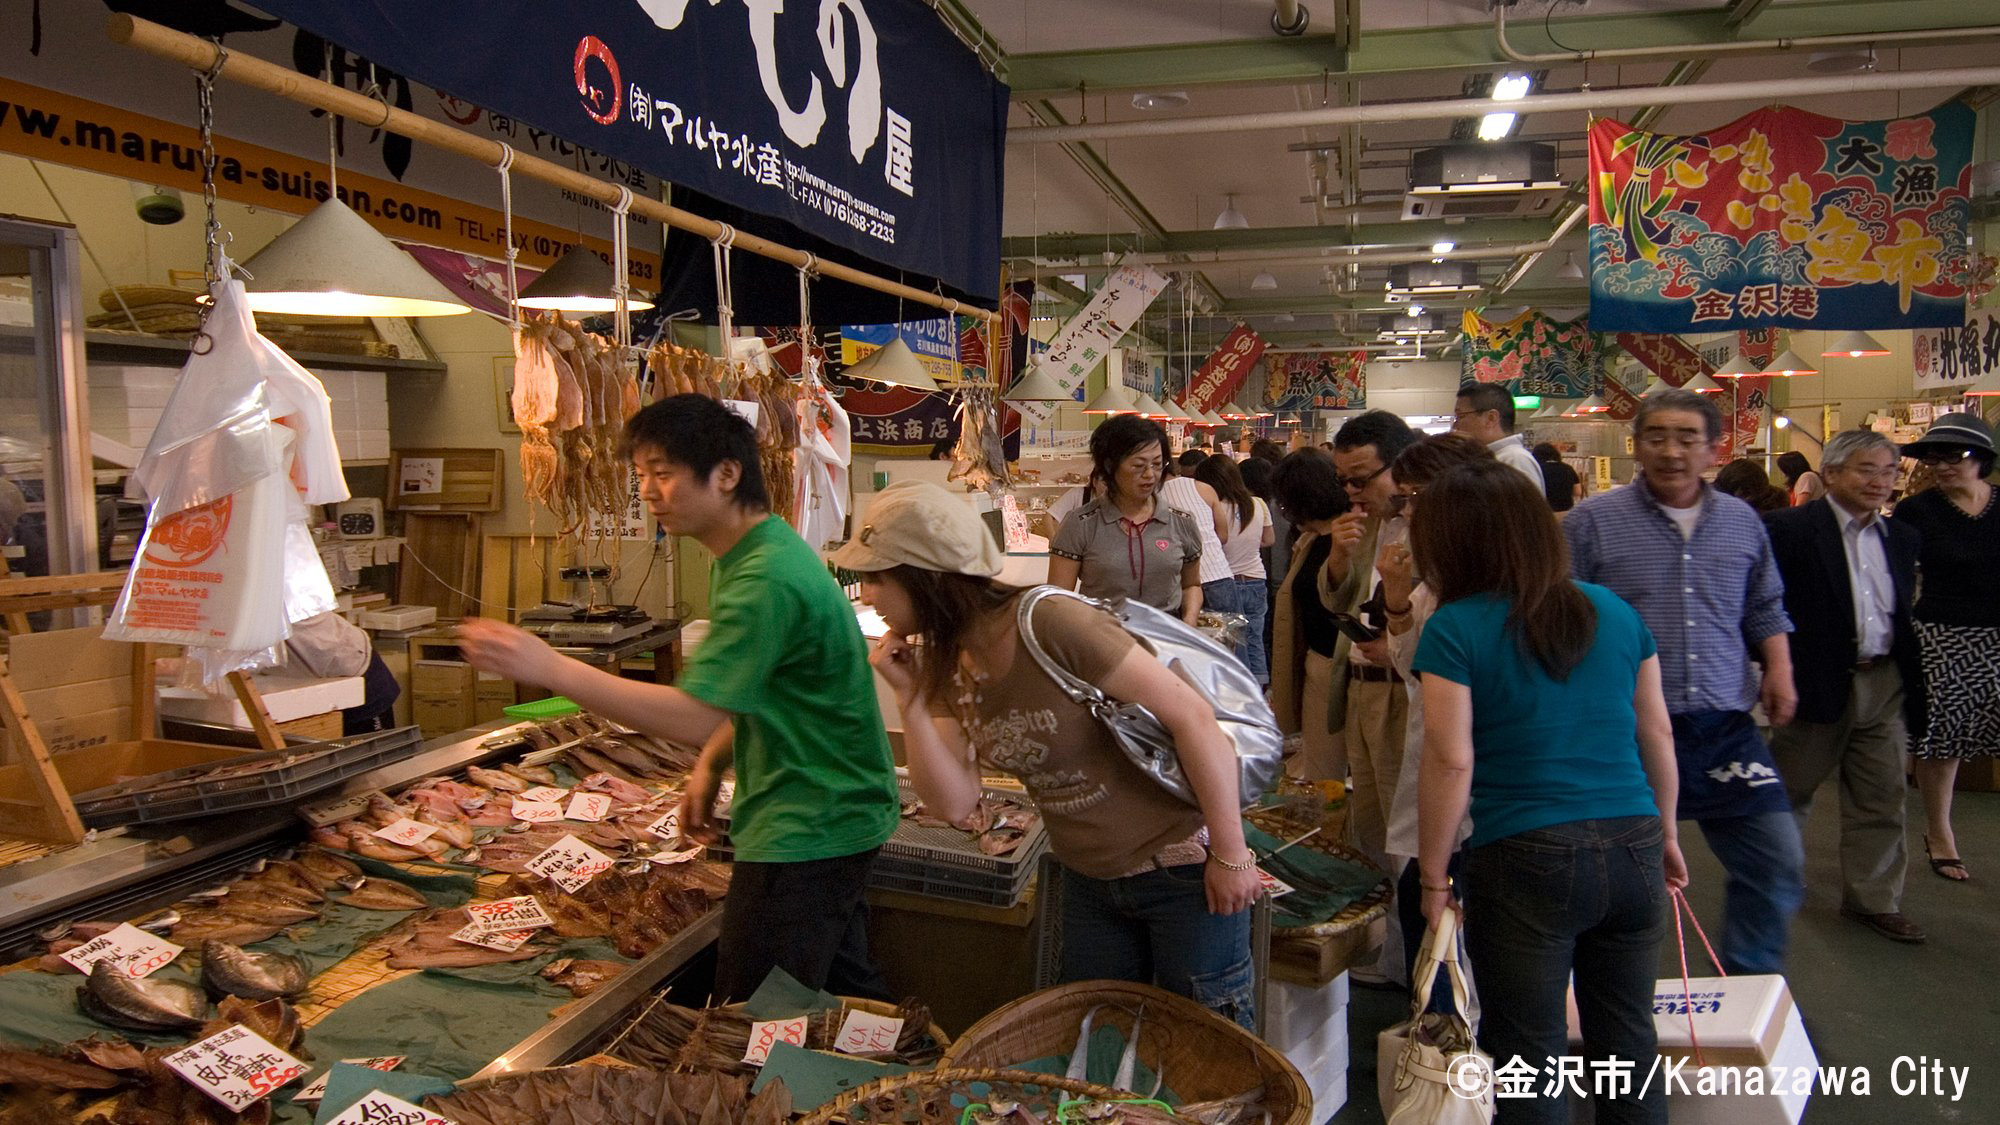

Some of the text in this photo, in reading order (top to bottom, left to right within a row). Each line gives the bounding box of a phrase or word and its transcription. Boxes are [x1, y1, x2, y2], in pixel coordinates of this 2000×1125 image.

[0, 102, 442, 230] w.maruya-suisan.com
[1837, 138, 1939, 204] 大漁
[1692, 283, 1819, 323] 金沢港
[853, 416, 950, 442] 上浜商店
[129, 950, 173, 977] 600
[751, 1022, 778, 1057] 200
